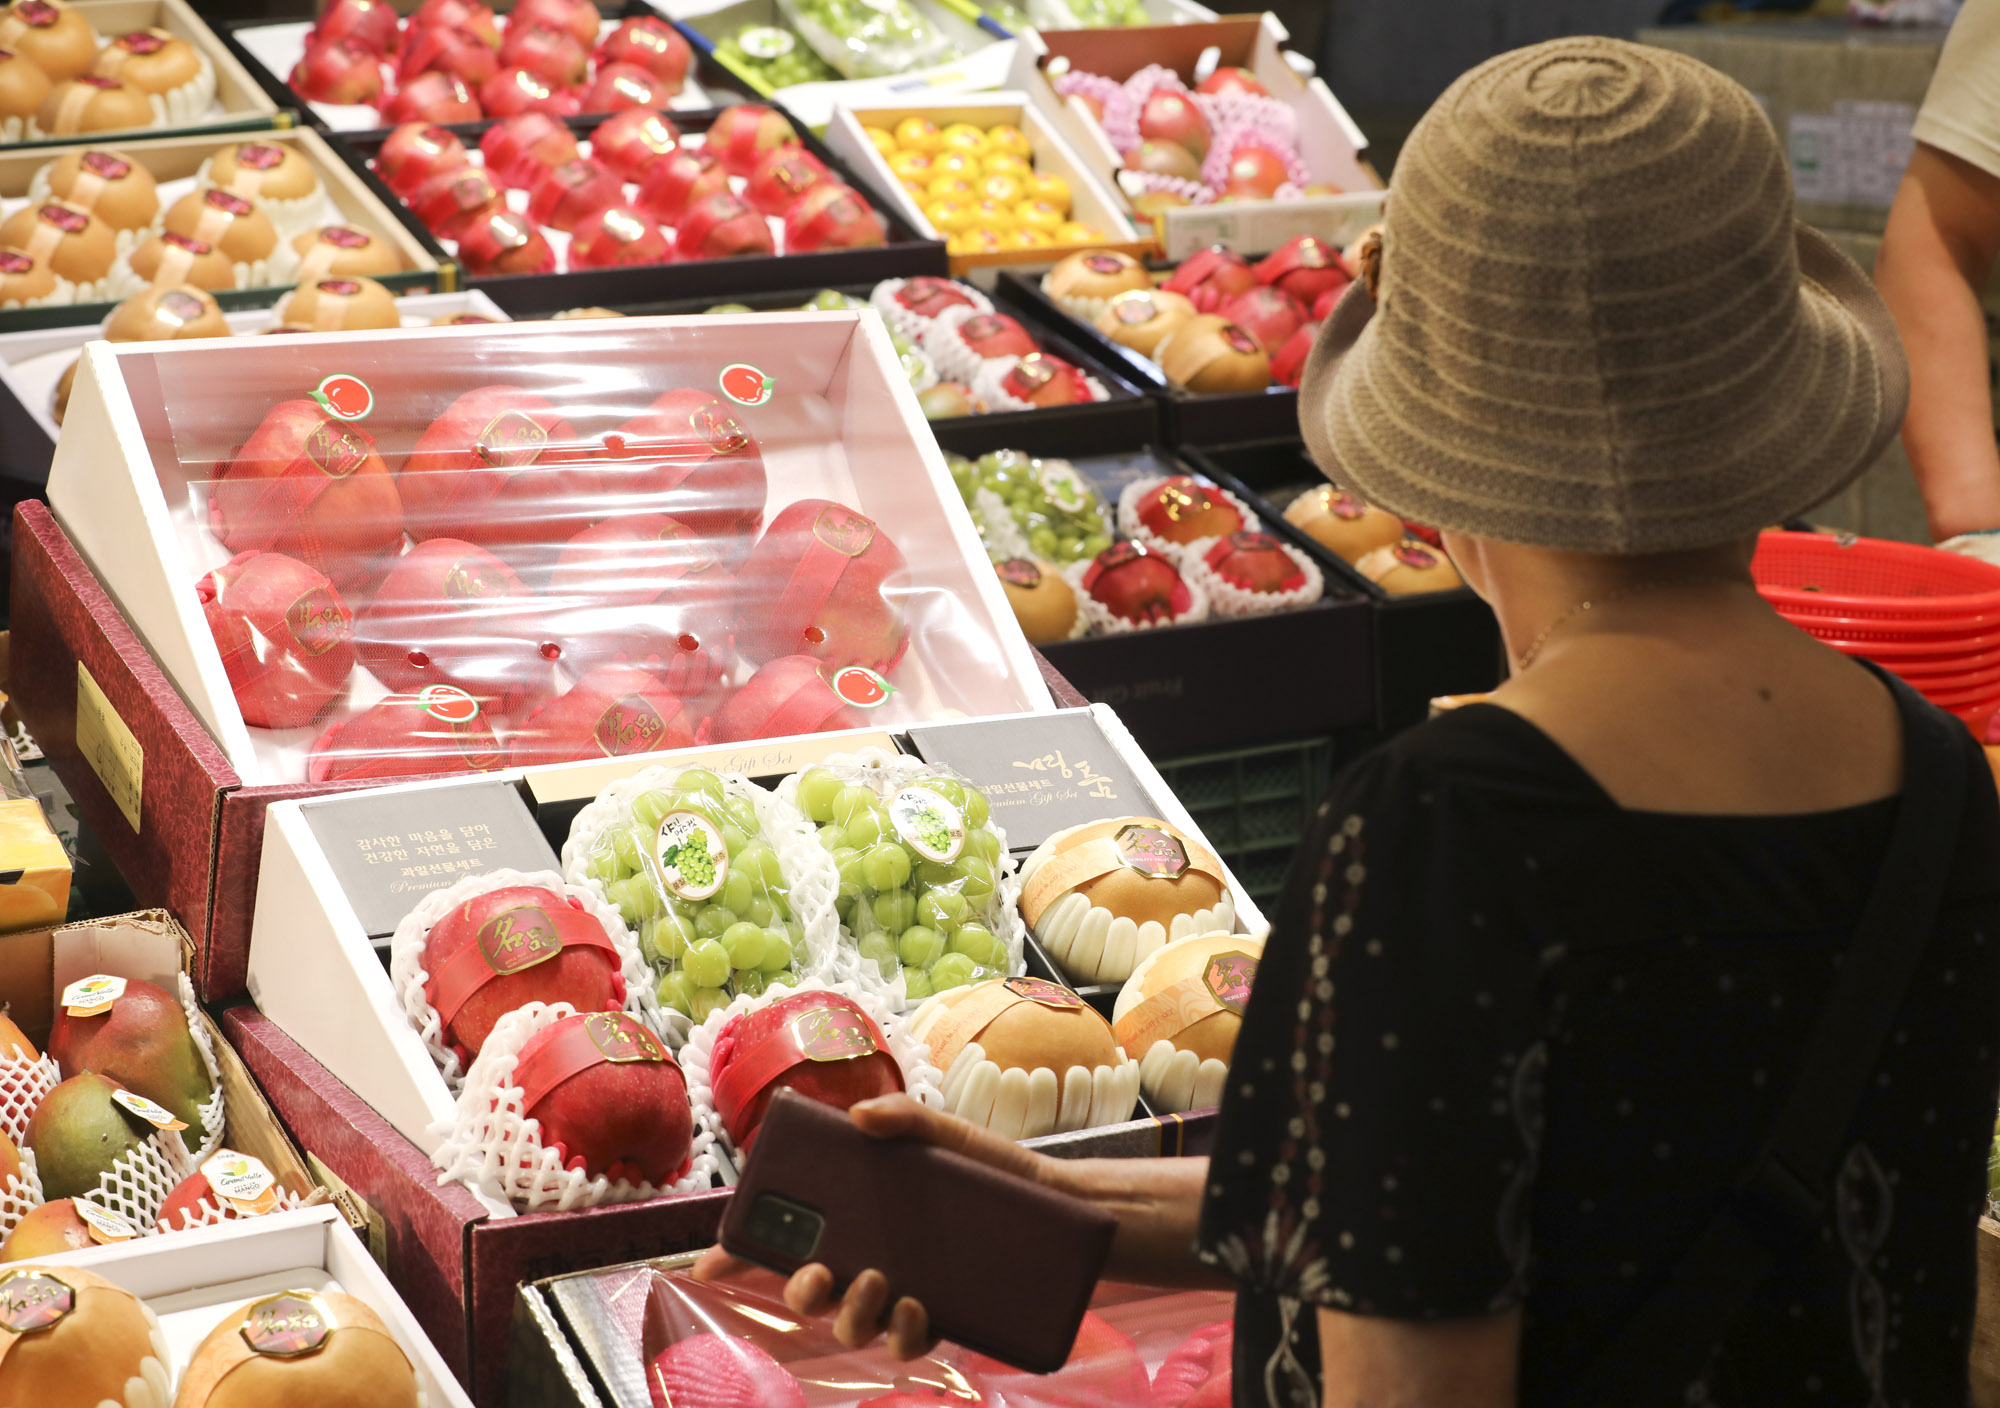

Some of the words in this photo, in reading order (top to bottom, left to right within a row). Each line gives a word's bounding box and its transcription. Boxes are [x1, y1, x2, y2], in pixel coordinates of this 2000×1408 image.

[356, 835, 401, 851] 감사한
[408, 828, 454, 844] 마음을
[459, 823, 490, 838] 담아
[363, 848, 409, 865] 건강한
[415, 842, 461, 857] 자연을
[466, 837, 497, 851] 담은
[400, 858, 484, 877] 과일선물세트
[390, 880, 451, 893] Premium
[492, 916, 556, 959] 名品
[806, 1013, 872, 1047] 名品
